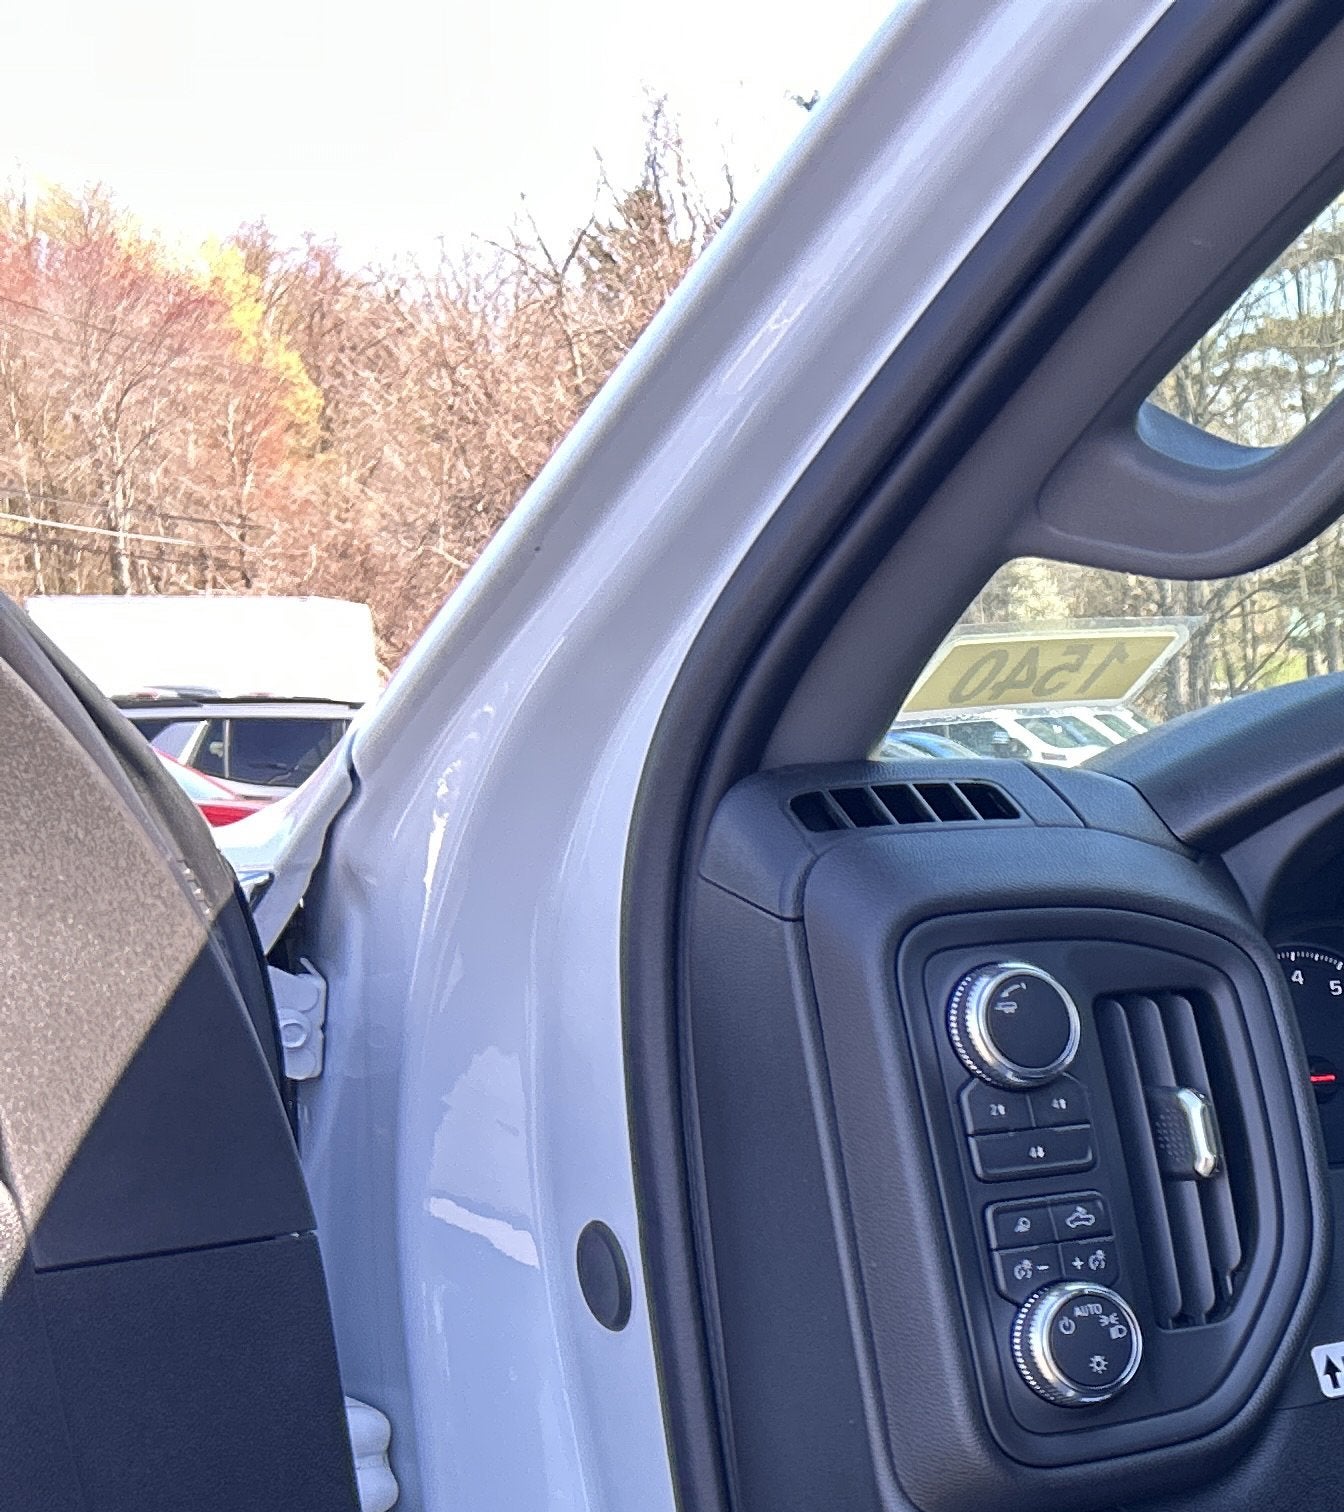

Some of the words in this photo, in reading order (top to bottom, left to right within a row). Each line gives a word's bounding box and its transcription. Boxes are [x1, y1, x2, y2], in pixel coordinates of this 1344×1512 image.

[1290, 969, 1304, 986] 4
[1328, 979, 1343, 997] 5
[1074, 1303, 1103, 1318] AUTO
